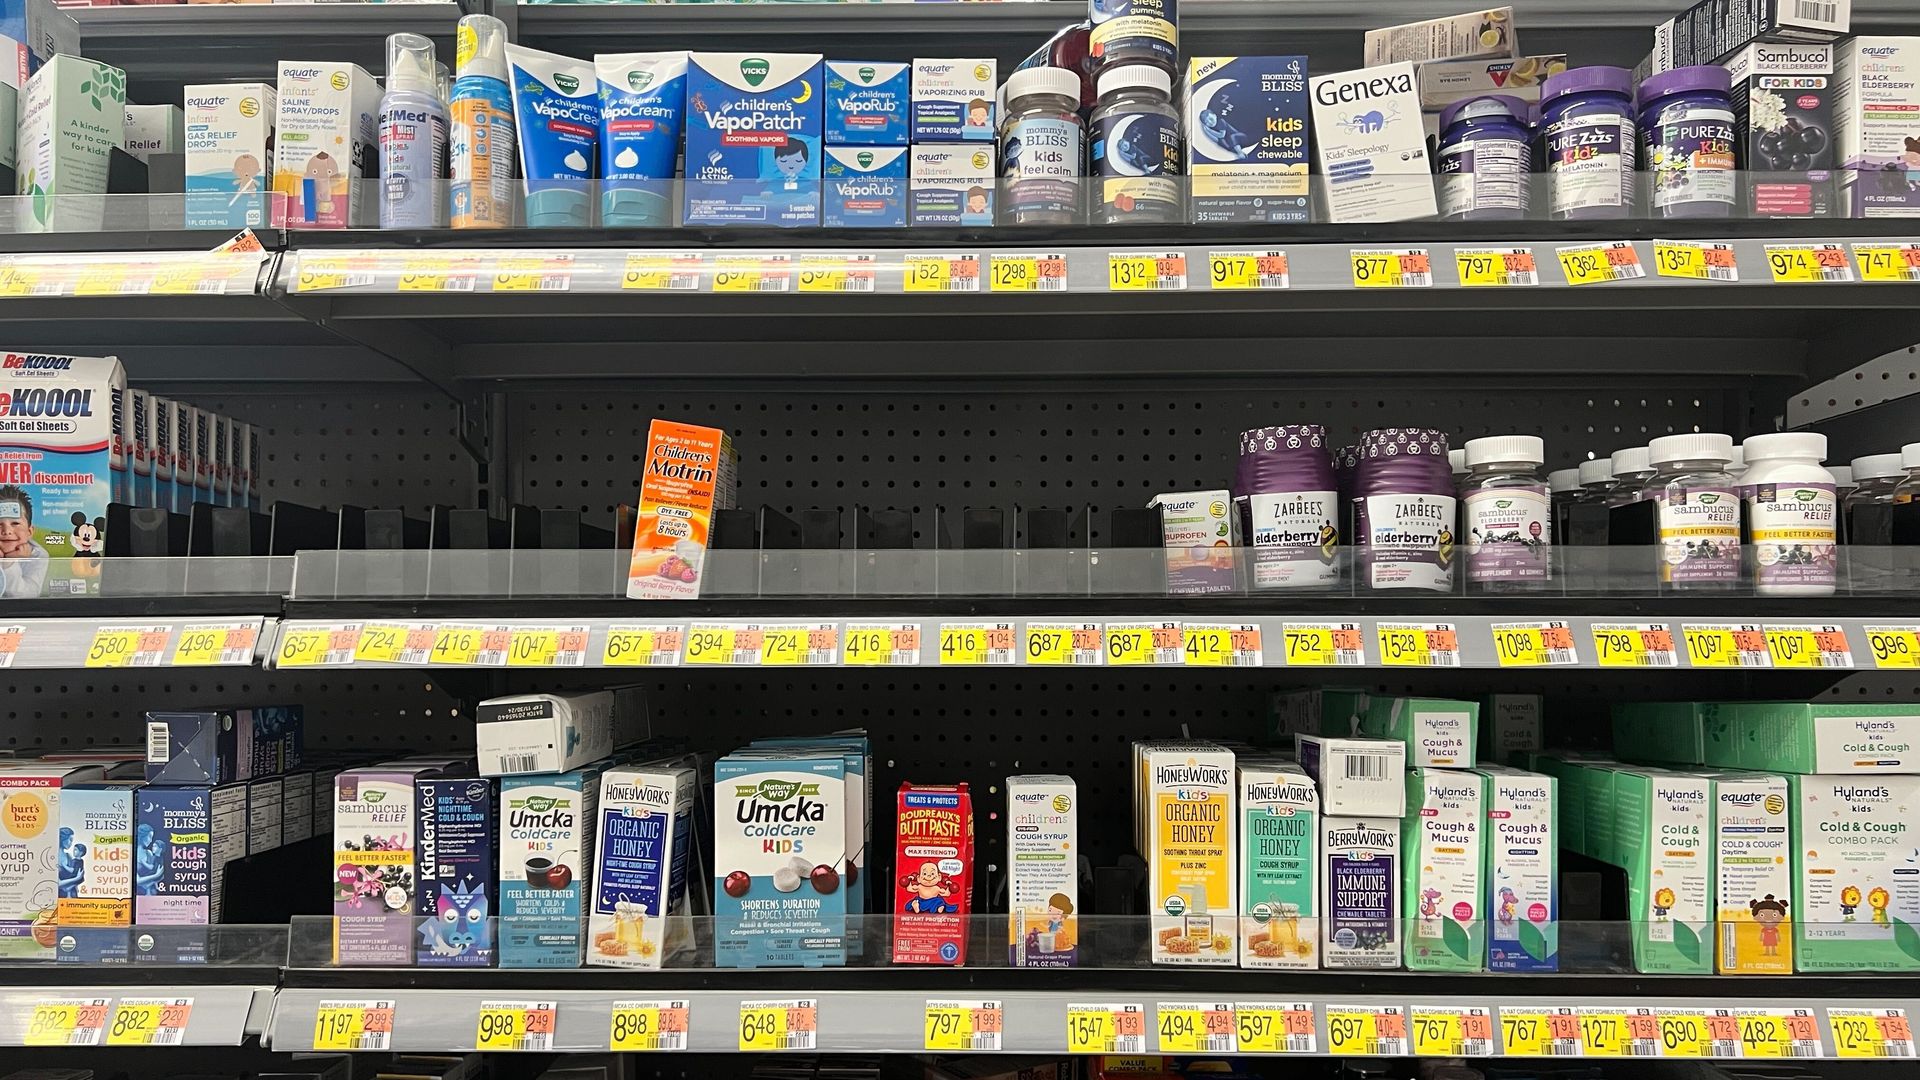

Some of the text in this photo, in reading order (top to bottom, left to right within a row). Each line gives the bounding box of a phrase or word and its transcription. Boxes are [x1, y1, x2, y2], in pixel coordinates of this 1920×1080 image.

[1758, 49, 1828, 62] Sambucol
[1862, 47, 1895, 55] equate
[284, 68, 318, 79] equate
[743, 67, 767, 75] VICKS
[920, 65, 949, 74] equate
[1196, 60, 1217, 76] new
[1262, 81, 1302, 91] BLISS
[1316, 74, 1412, 106] Genexa
[859, 91, 894, 99] children's
[735, 99, 791, 111] children's
[838, 99, 895, 113] VapoRub
[282, 107, 339, 116] SPRAY/DROPS
[705, 112, 801, 133] VapoPatch
[1266, 118, 1302, 130] kids
[188, 131, 238, 139] GAS RELIEF
[1681, 127, 1715, 138] PURE
[130, 139, 160, 150] Relief
[188, 140, 217, 148] DROPS
[1262, 136, 1302, 148] sleep
[1258, 150, 1302, 158] chewable
[1562, 146, 1599, 163] Kidz
[702, 167, 728, 175] LONG
[1025, 165, 1071, 176] feel calm
[19, 421, 34, 430] Gel
[37, 421, 69, 431] Sheets
[655, 445, 711, 462] Children's
[648, 459, 712, 482] Motrin
[35, 474, 93, 484] discomfort
[1767, 502, 1832, 511] sambucus
[664, 526, 686, 536] hours
[1256, 531, 1319, 543] elderberry
[1844, 744, 1866, 752] Cold
[1877, 744, 1910, 753] Cough
[1500, 788, 1545, 799] Hyland's
[1721, 792, 1761, 804] equate
[1834, 786, 1889, 799] Hyland's
[908, 796, 926, 804] TREATS
[933, 797, 957, 805] PROTECTS
[11, 804, 40, 813] burt's
[338, 803, 407, 814] sambucus
[737, 799, 824, 824] Umcka
[1166, 804, 1220, 822] ORGANIC
[14, 813, 37, 822] bees
[164, 818, 207, 828] BLISS
[372, 814, 406, 822] RELIEF
[510, 811, 573, 828] Umcka
[421, 785, 435, 881] KinderMed
[610, 819, 659, 839] ORGANIC
[900, 822, 960, 836] BUTT PASTE
[1499, 824, 1536, 834] Cough
[1820, 822, 1850, 832] Cold
[1864, 822, 1905, 833] Cough
[1172, 825, 1215, 842] HONEY
[100, 836, 128, 844] Organic
[1505, 836, 1542, 844] Mucus
[172, 847, 206, 858] kids
[613, 839, 652, 857] HONEY
[171, 860, 206, 870] cough
[175, 872, 206, 882] syrup
[170, 884, 206, 892] mucus
[1337, 875, 1385, 891] IMMUNE
[741, 899, 820, 910] SHORTENS DURATION
[1337, 892, 1387, 907] SUPPORT
